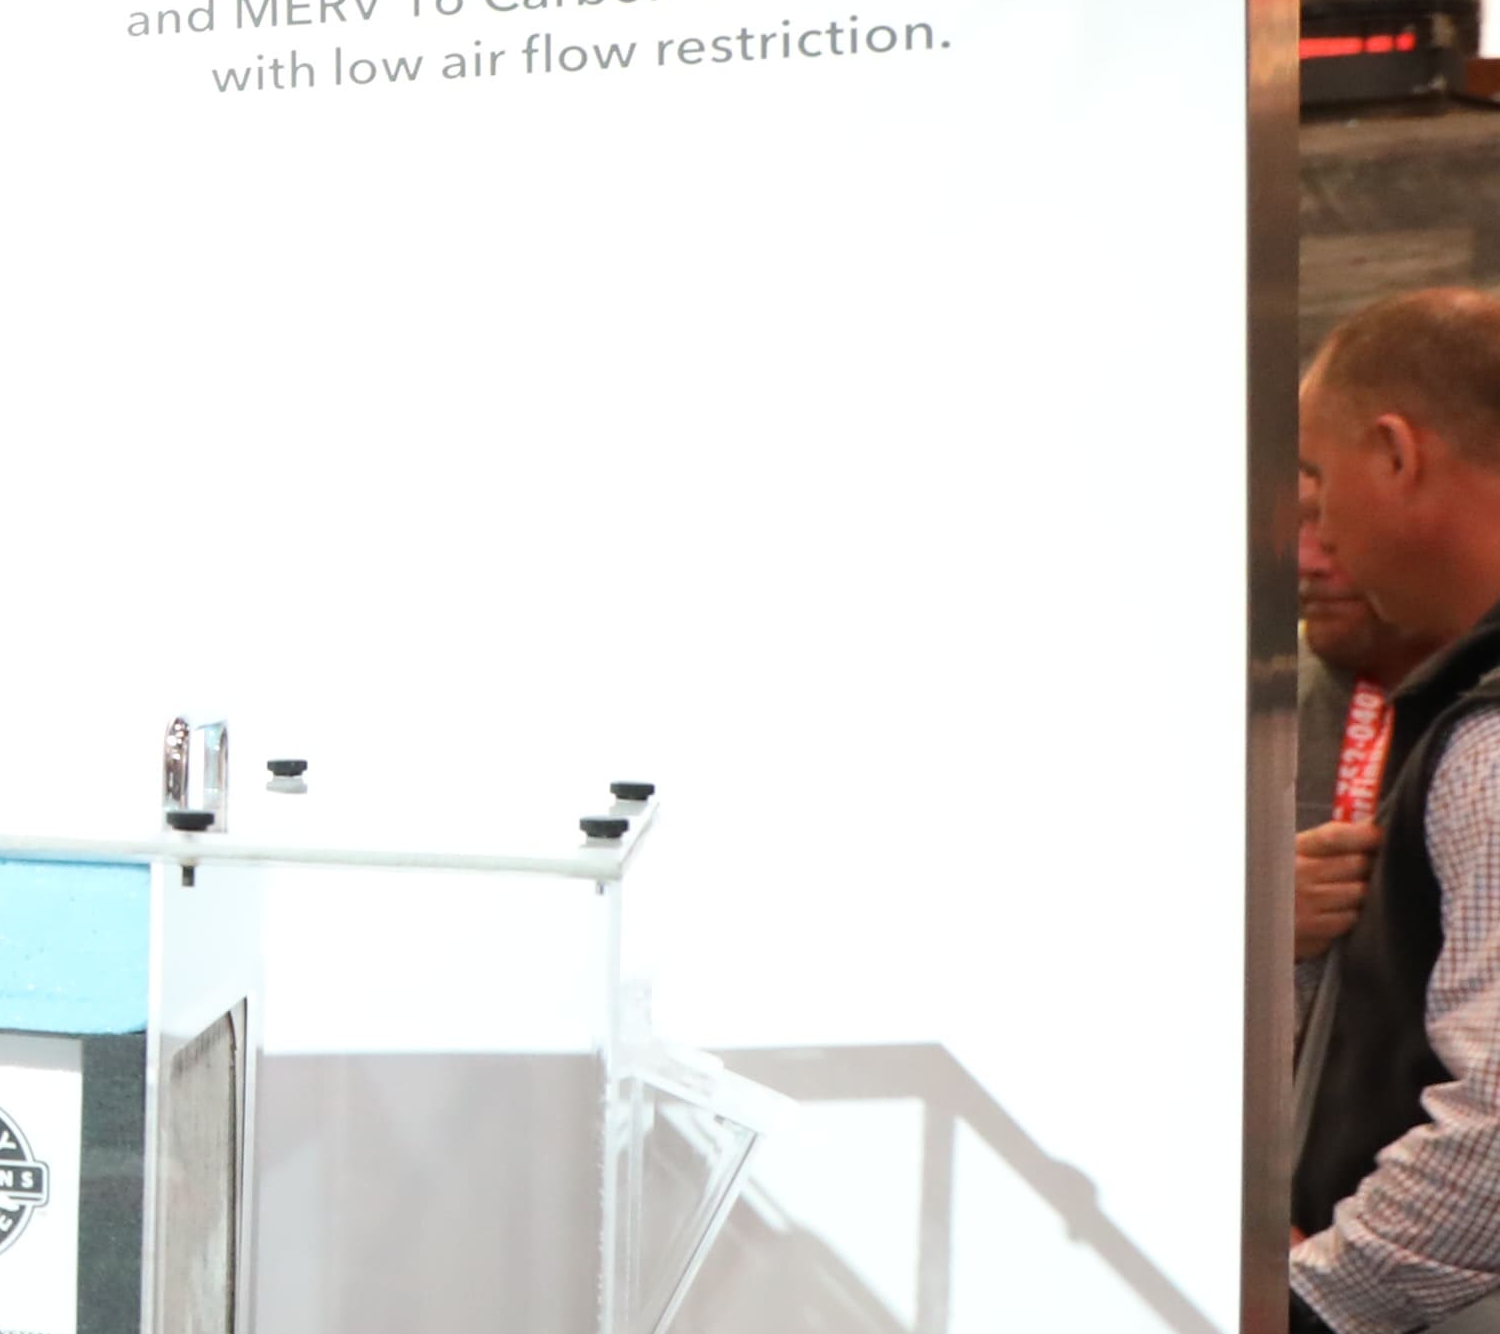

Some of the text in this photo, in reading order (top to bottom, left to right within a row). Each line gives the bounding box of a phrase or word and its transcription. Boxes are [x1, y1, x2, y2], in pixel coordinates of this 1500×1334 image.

[211, 13, 953, 94] with low air flow restriction.
